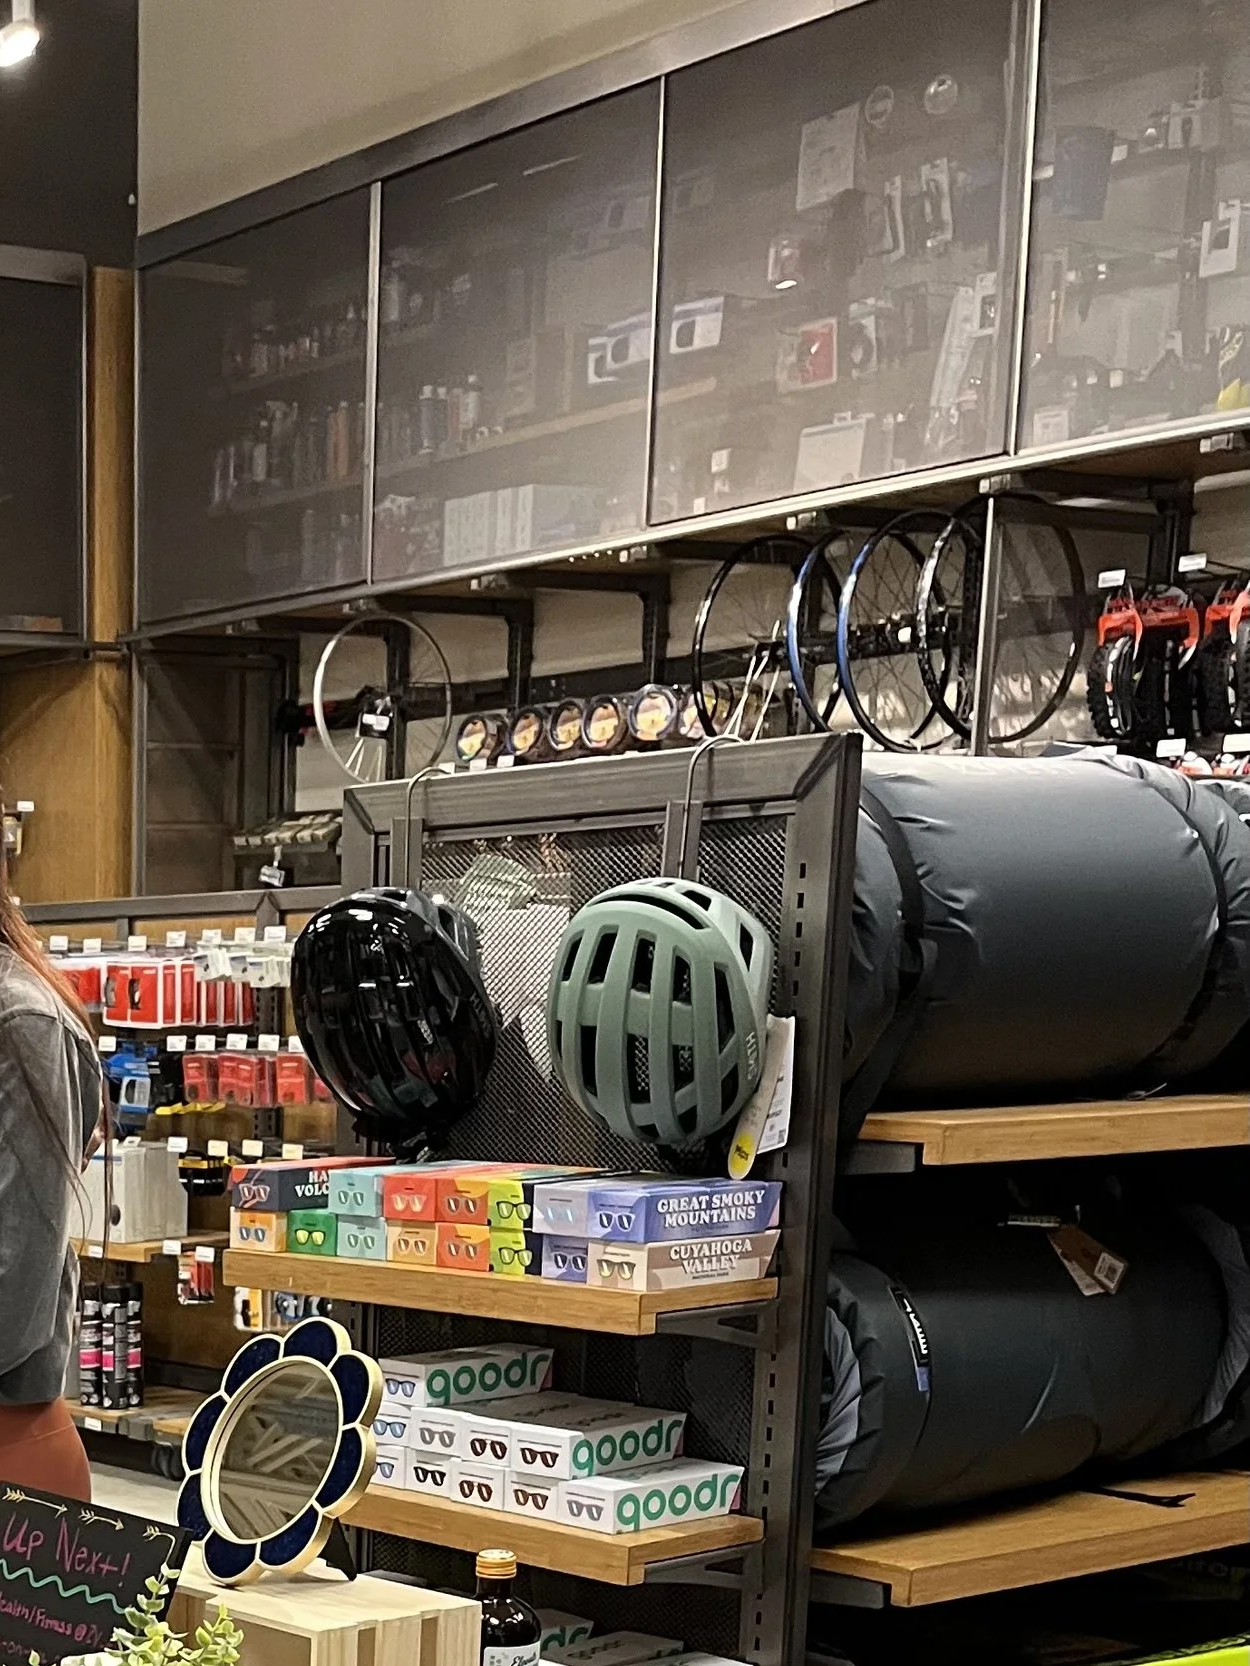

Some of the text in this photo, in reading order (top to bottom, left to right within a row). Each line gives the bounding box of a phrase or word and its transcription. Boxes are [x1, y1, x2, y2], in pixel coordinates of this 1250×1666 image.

[657, 1190, 765, 1214] GREAT SMOKY
[665, 1206, 756, 1228] MOUNTAINS
[670, 1239, 753, 1260] CUYAHOGA
[681, 1255, 740, 1275] VALLEY
[427, 1352, 550, 1405] goodr
[572, 1419, 682, 1478] goodr
[617, 1473, 740, 1531] goodr
